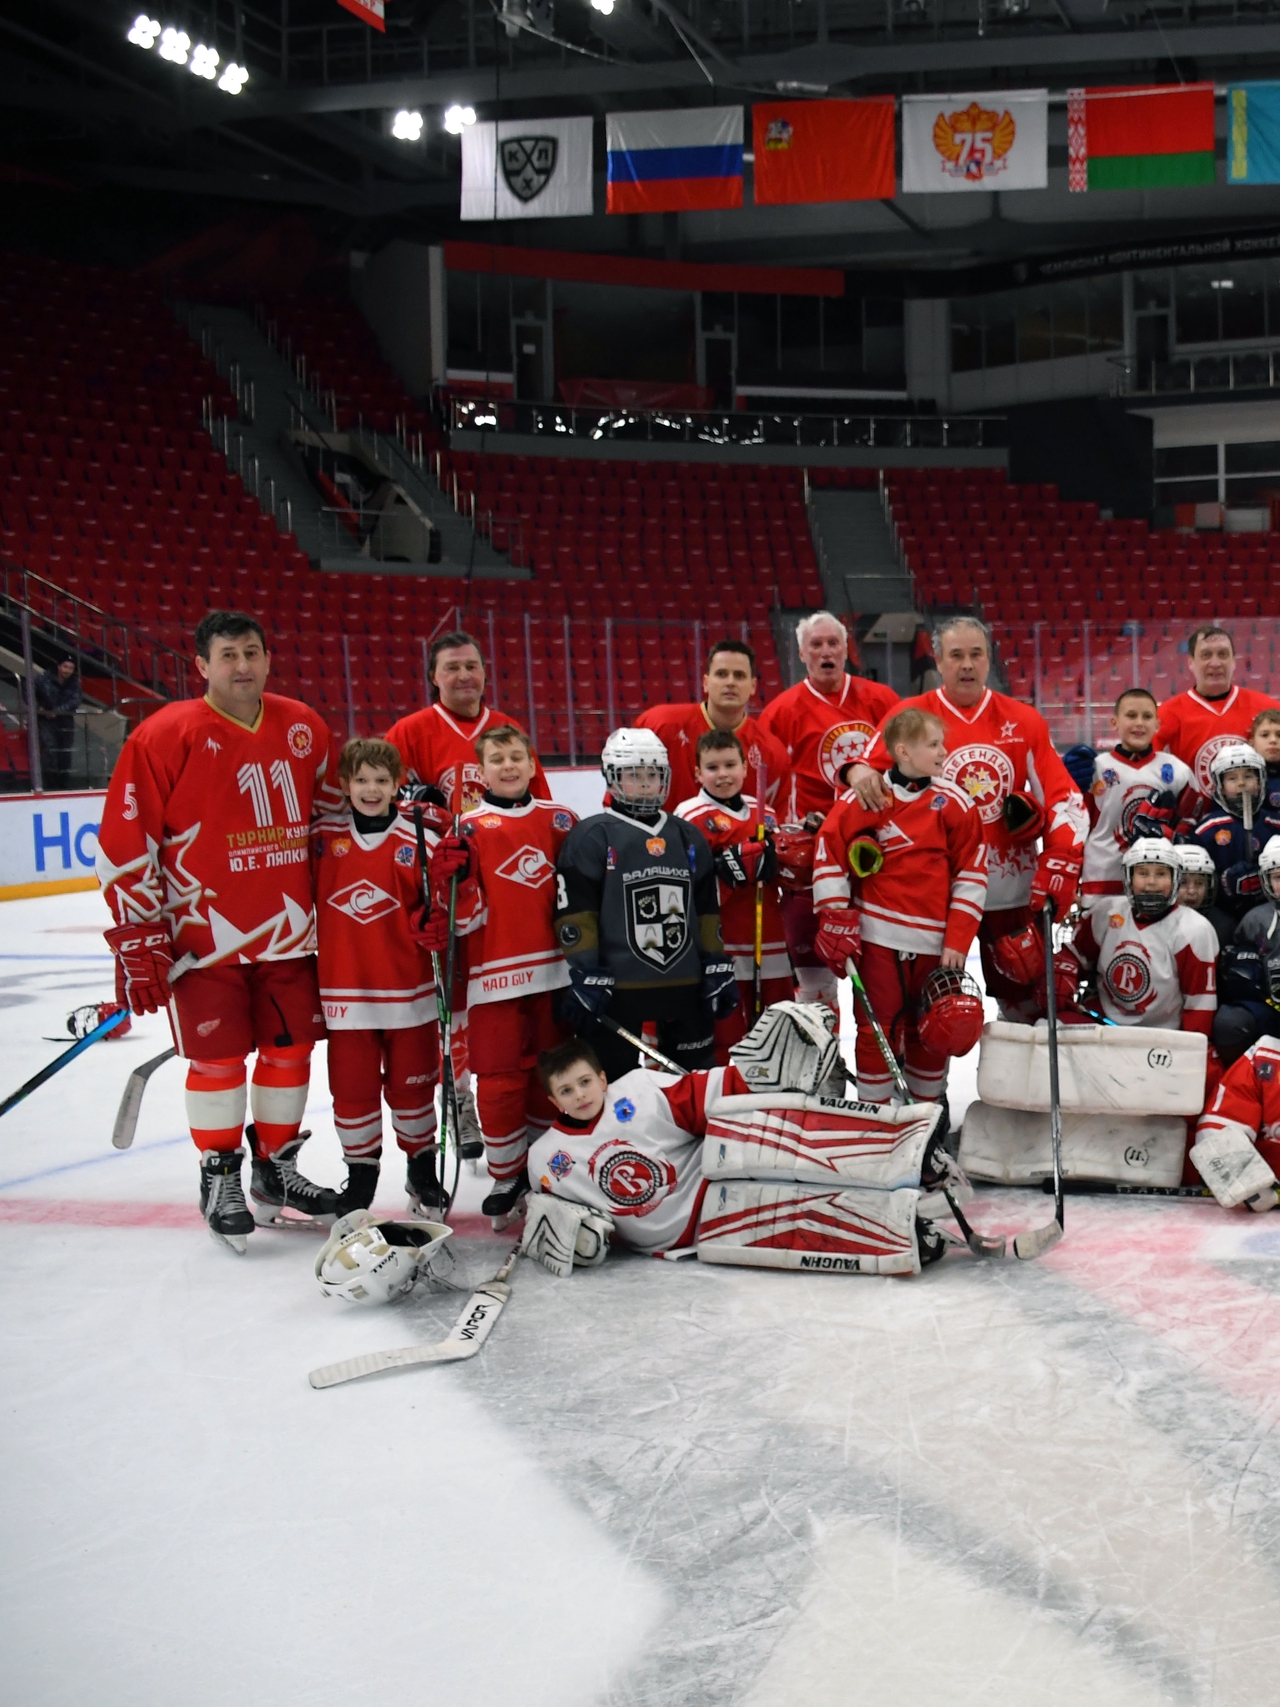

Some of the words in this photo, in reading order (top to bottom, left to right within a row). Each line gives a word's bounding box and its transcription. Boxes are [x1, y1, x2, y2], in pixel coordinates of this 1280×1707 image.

[954, 132, 993, 167] 75
[944, 750, 1008, 782] ЛЕГЕНДЫ
[122, 783, 139, 821] 5
[237, 759, 302, 828] 11
[226, 826, 286, 848] ТУРНИР
[228, 843, 279, 858] ОЛИМПИЙСКОГО
[229, 855, 261, 873] Ю.Е.
[482, 974, 508, 993] MAD
[512, 971, 534, 988] GUY
[819, 1096, 882, 1115] VAUGHN
[800, 1255, 862, 1272] VAUGHN
[459, 1303, 497, 1341] VAPOR
